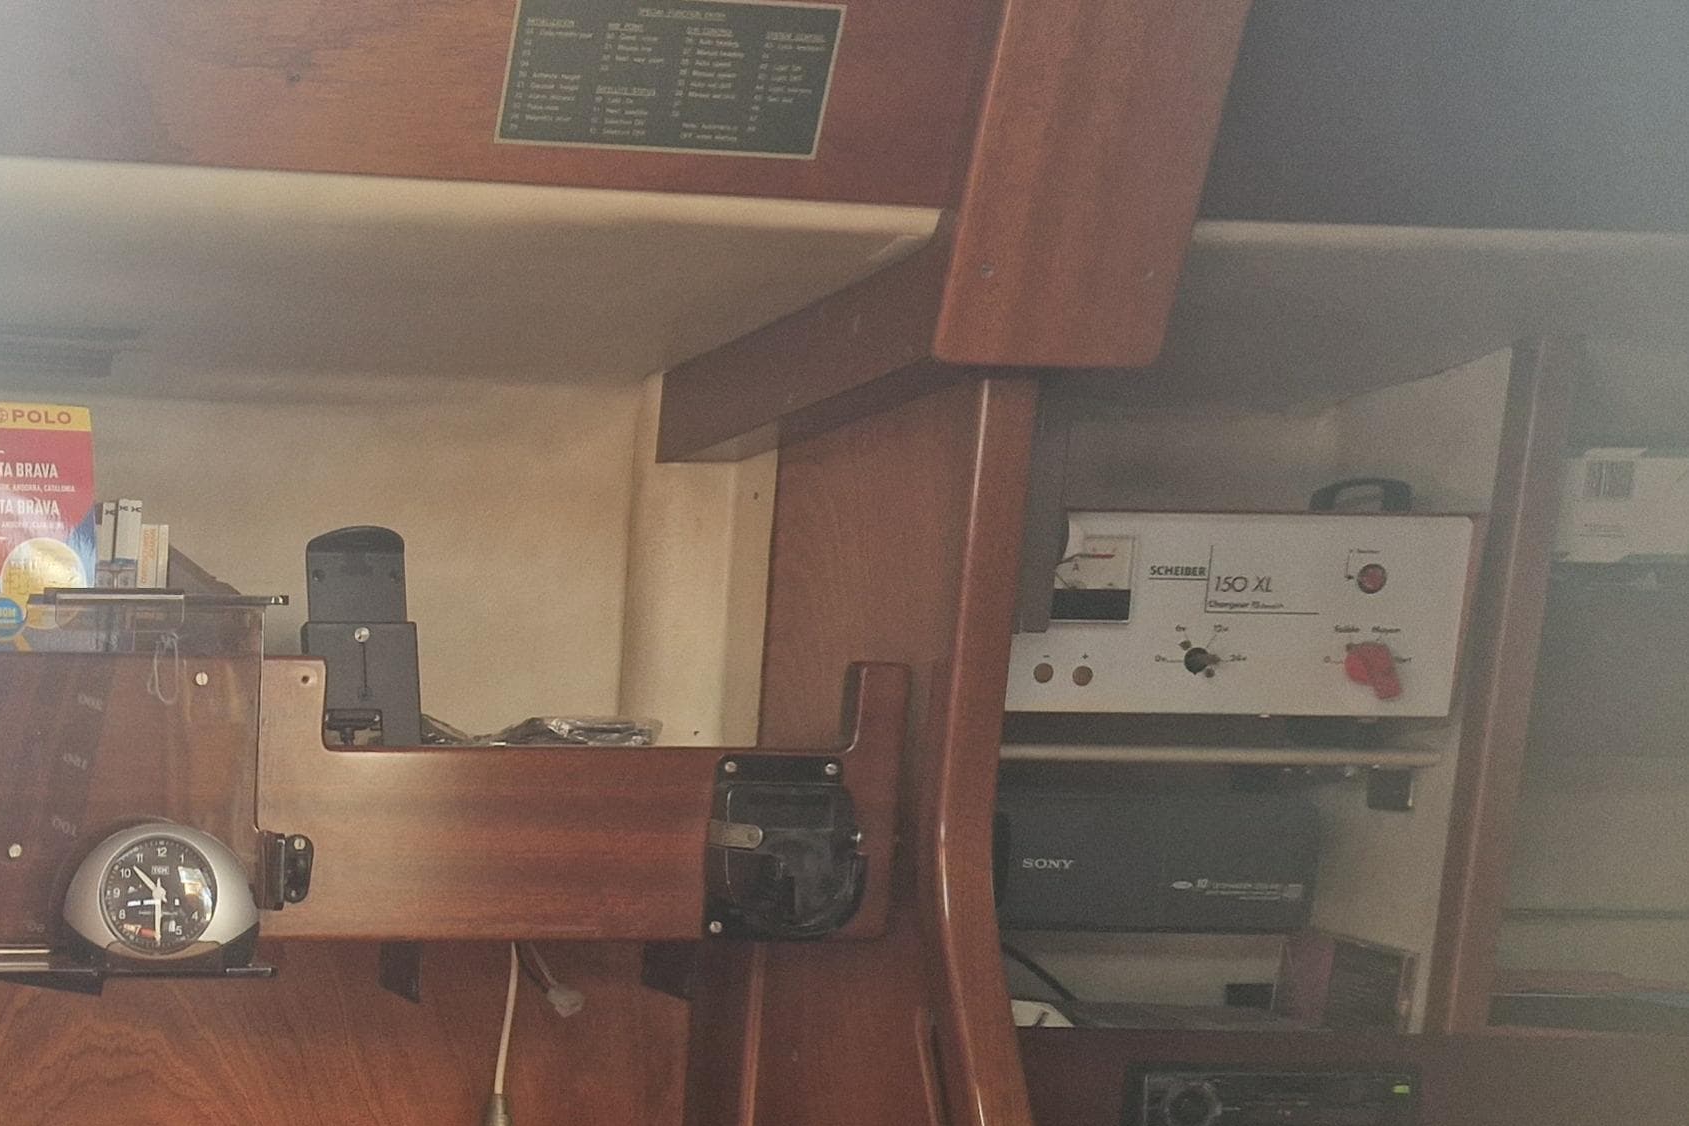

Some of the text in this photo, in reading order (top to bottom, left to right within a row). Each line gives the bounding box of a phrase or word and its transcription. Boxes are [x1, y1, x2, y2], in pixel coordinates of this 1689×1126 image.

[12, 409, 72, 425] POLO
[16, 462, 59, 479] BRAVA
[17, 499, 60, 516] BRAVA
[1149, 565, 1207, 576] SCHEIBER
[1215, 576, 1274, 594] 150 XL
[157, 847, 167, 857] 12
[136, 853, 144, 863] 11
[180, 854, 185, 864] 1
[1022, 858, 1074, 869] SONY
[120, 868, 131, 878] 10
[113, 887, 120, 898] 9
[118, 909, 126, 919] 8
[191, 911, 199, 921] 4
[175, 925, 183, 935] 5
